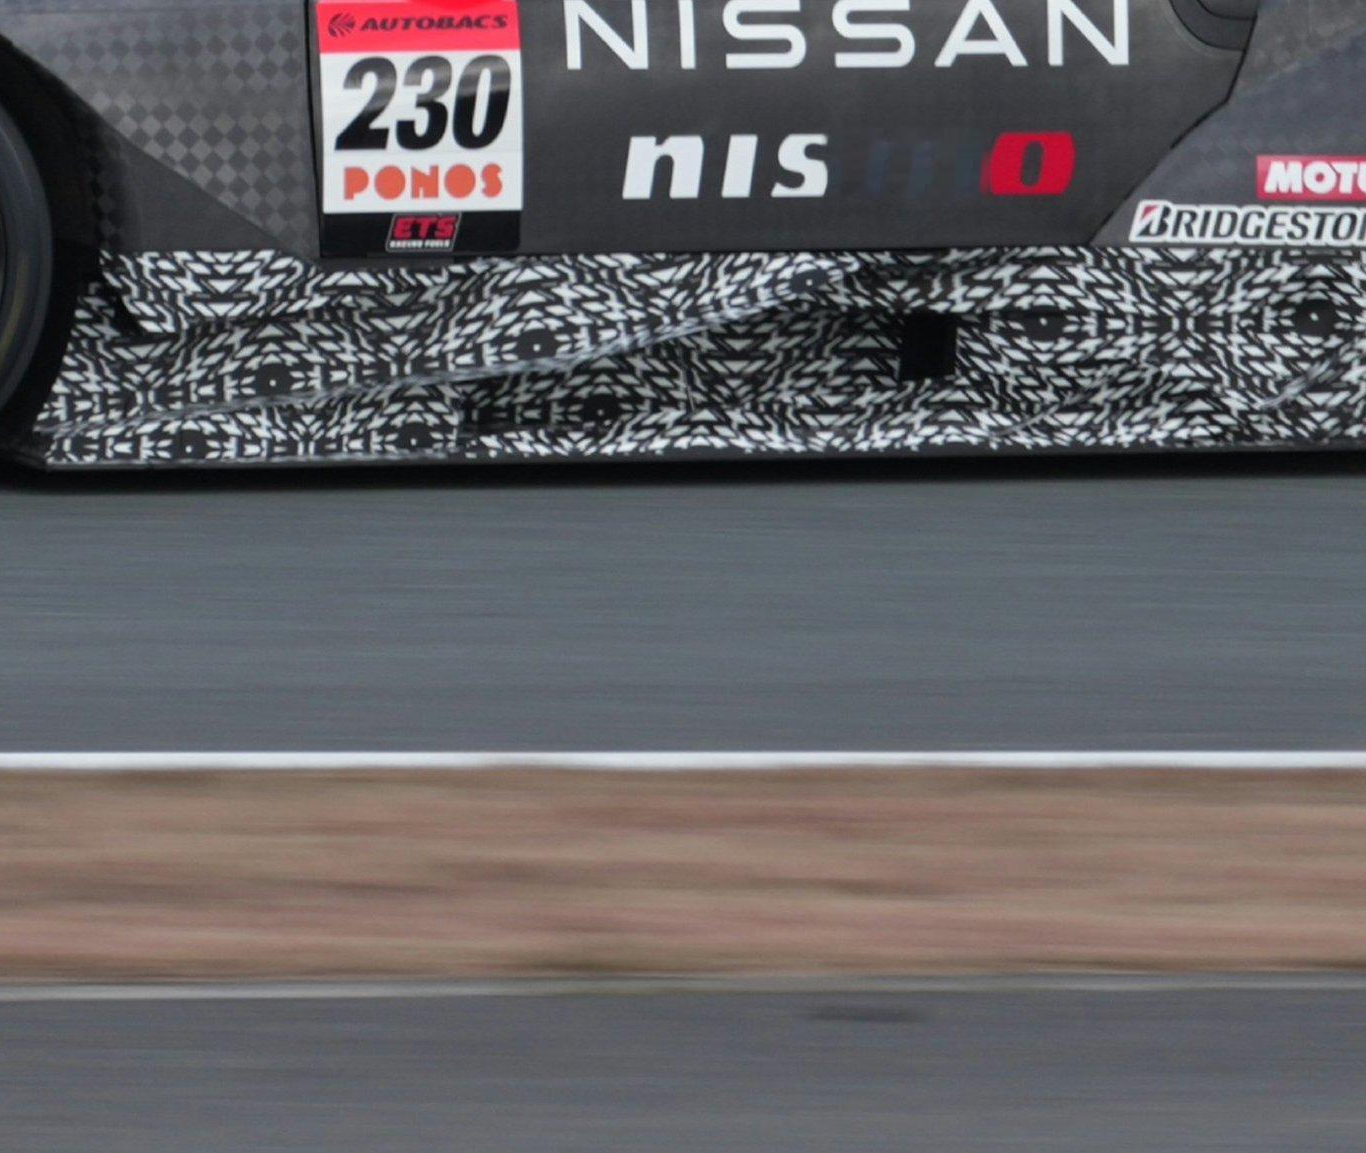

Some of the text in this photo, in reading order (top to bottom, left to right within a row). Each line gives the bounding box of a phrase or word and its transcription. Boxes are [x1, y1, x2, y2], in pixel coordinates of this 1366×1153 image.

[359, 14, 509, 32] AUTOBACS
[334, 54, 512, 151] 230
[343, 163, 504, 201] PONOS
[393, 215, 458, 241] ETS
